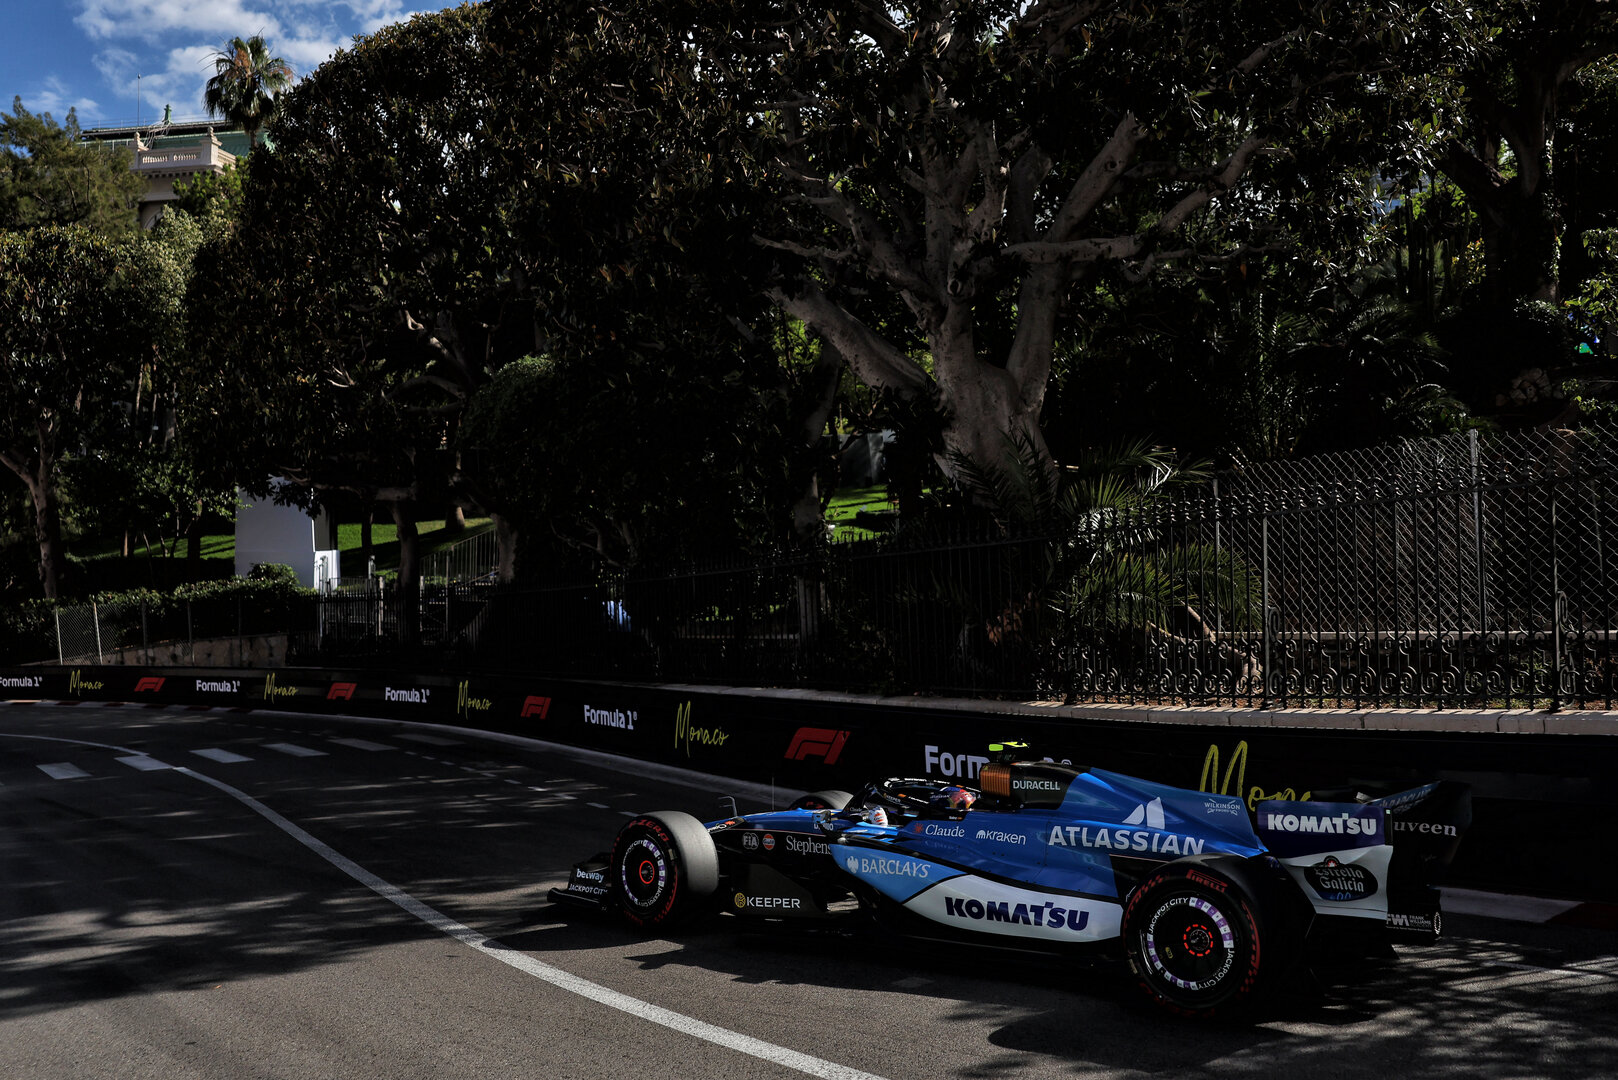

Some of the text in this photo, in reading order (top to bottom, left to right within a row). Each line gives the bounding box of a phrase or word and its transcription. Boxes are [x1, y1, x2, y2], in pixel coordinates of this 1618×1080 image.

[69, 669, 104, 697] Monaco
[195, 679, 231, 693] Formula
[263, 672, 298, 704] Monaco
[384, 687, 420, 703] Formula
[457, 679, 492, 721] Monaco
[583, 704, 626, 729] Formula
[674, 700, 729, 759] Monaco
[924, 744, 990, 780] Form
[1012, 780, 1061, 791] DURACELL
[1204, 802, 1241, 810] WILKINSON
[925, 824, 965, 838] Claude
[1267, 812, 1377, 836] KOMATSU
[1393, 821, 1457, 837] uveen
[1048, 825, 1205, 855] ATLASSIAN
[576, 868, 605, 884] betway
[861, 858, 932, 879] BARCLAYS
[1314, 866, 1364, 879] Estrella
[568, 883, 594, 893] JACKPOT
[1185, 868, 1229, 894] PIRELLI
[1319, 876, 1365, 893] Galicia
[746, 896, 801, 909] KEEPER
[944, 896, 1090, 931] KOMATSU
[1148, 897, 1189, 934] JACKPOT CITY
[1198, 948, 1235, 990] JACKPOT CITY
